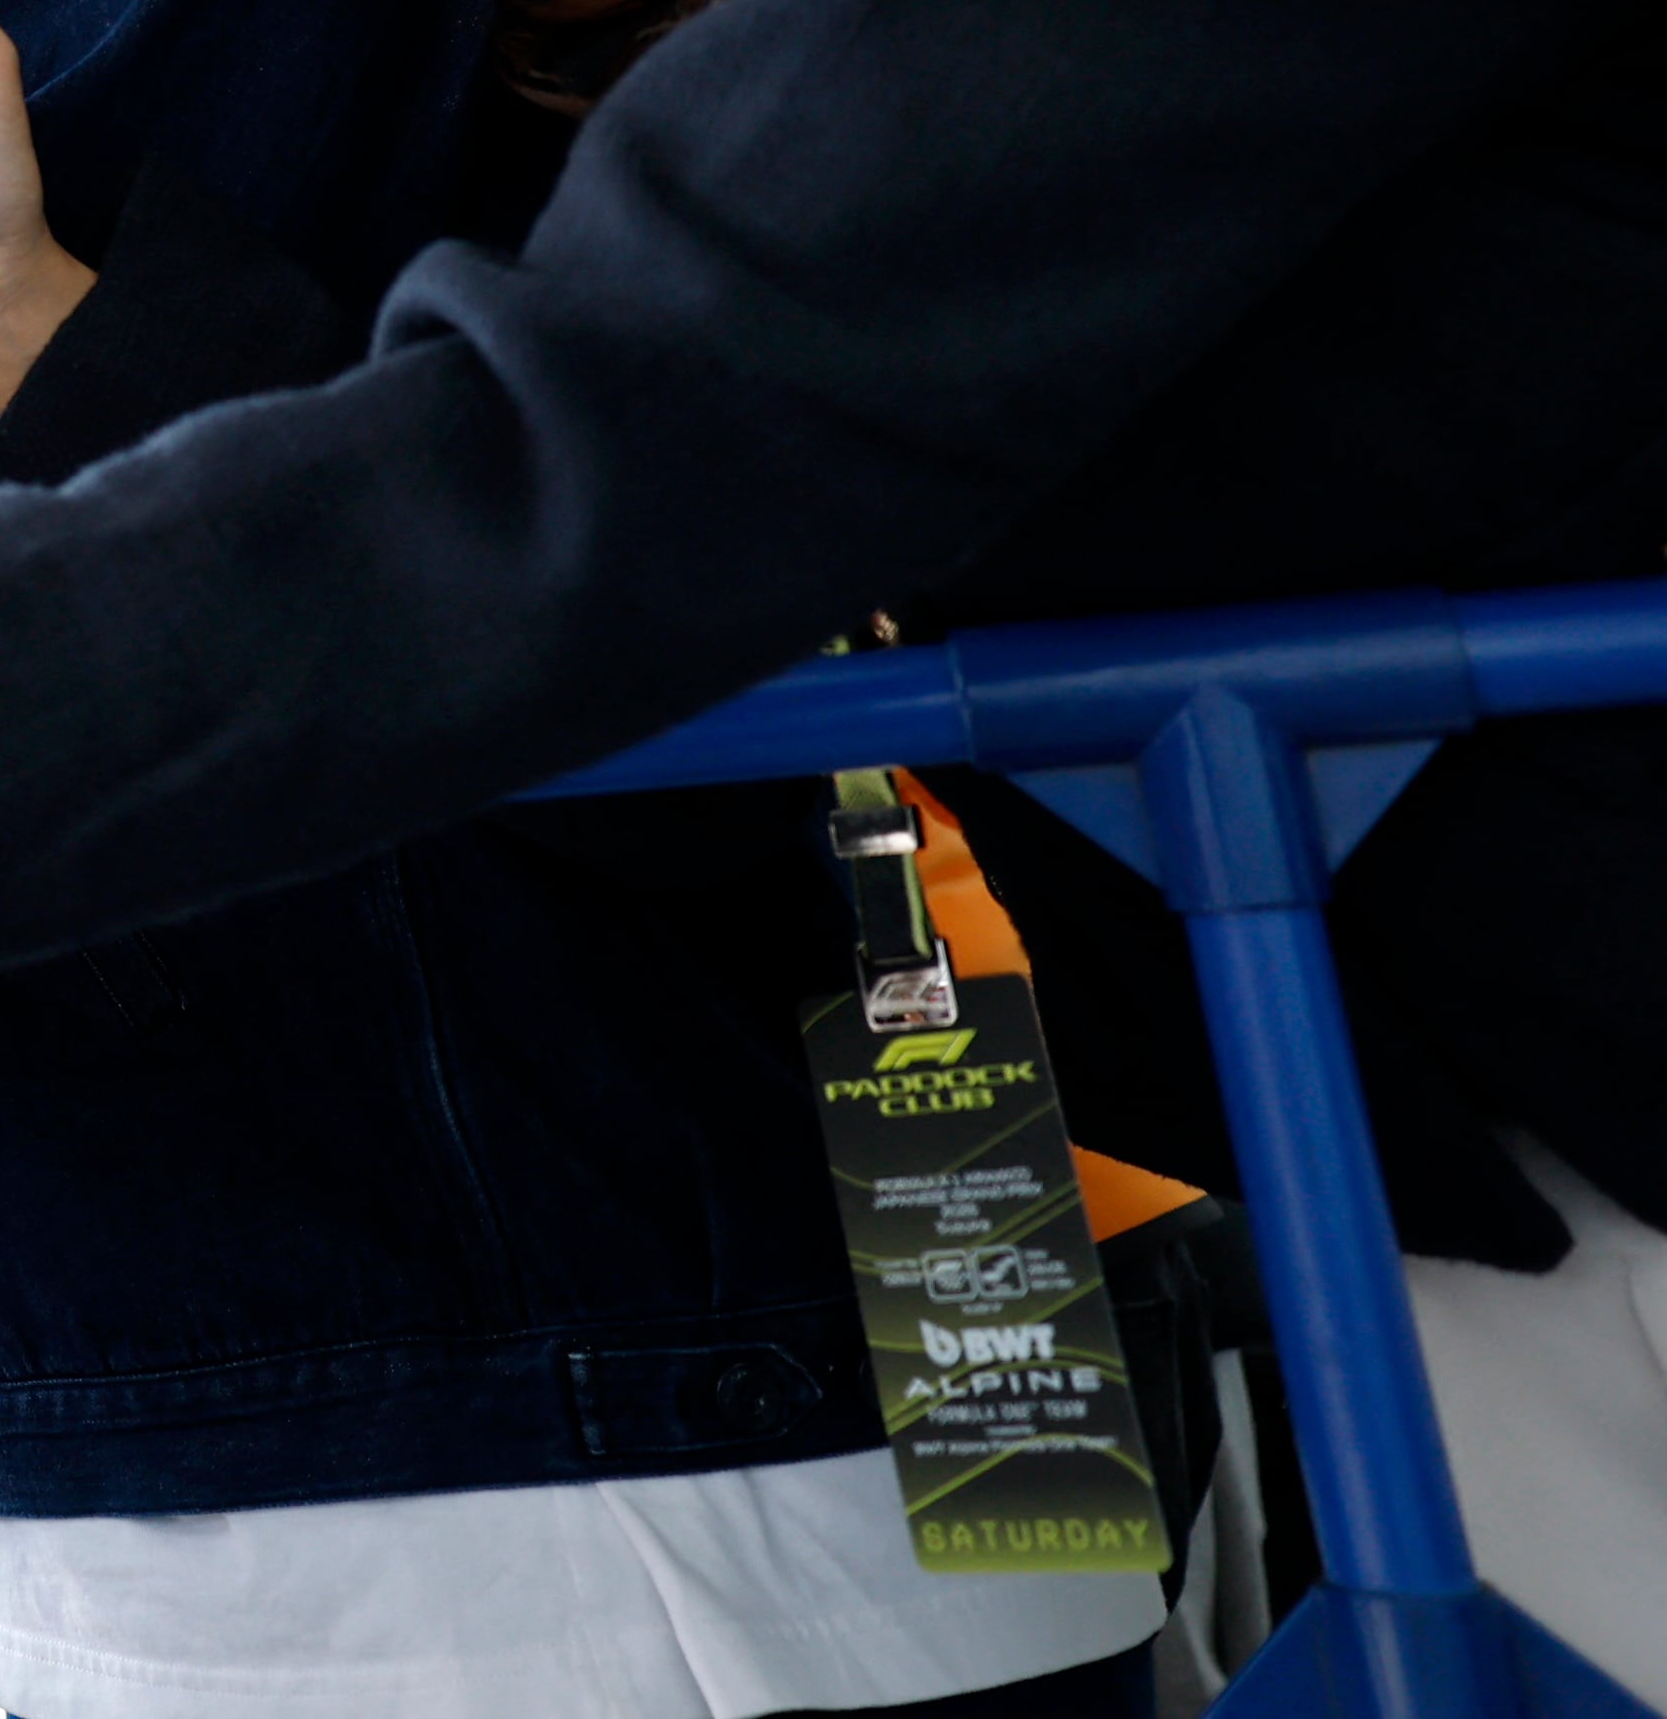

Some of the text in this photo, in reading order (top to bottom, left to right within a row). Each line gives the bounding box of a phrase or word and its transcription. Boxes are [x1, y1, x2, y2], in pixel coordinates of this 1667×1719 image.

[824, 1061, 1038, 1102] PADDOCK
[879, 1087, 996, 1118] CLUB
[961, 1323, 1056, 1365] BWT
[904, 1366, 1102, 1400] ALPINE
[921, 1519, 1149, 1553] SATURDAY
